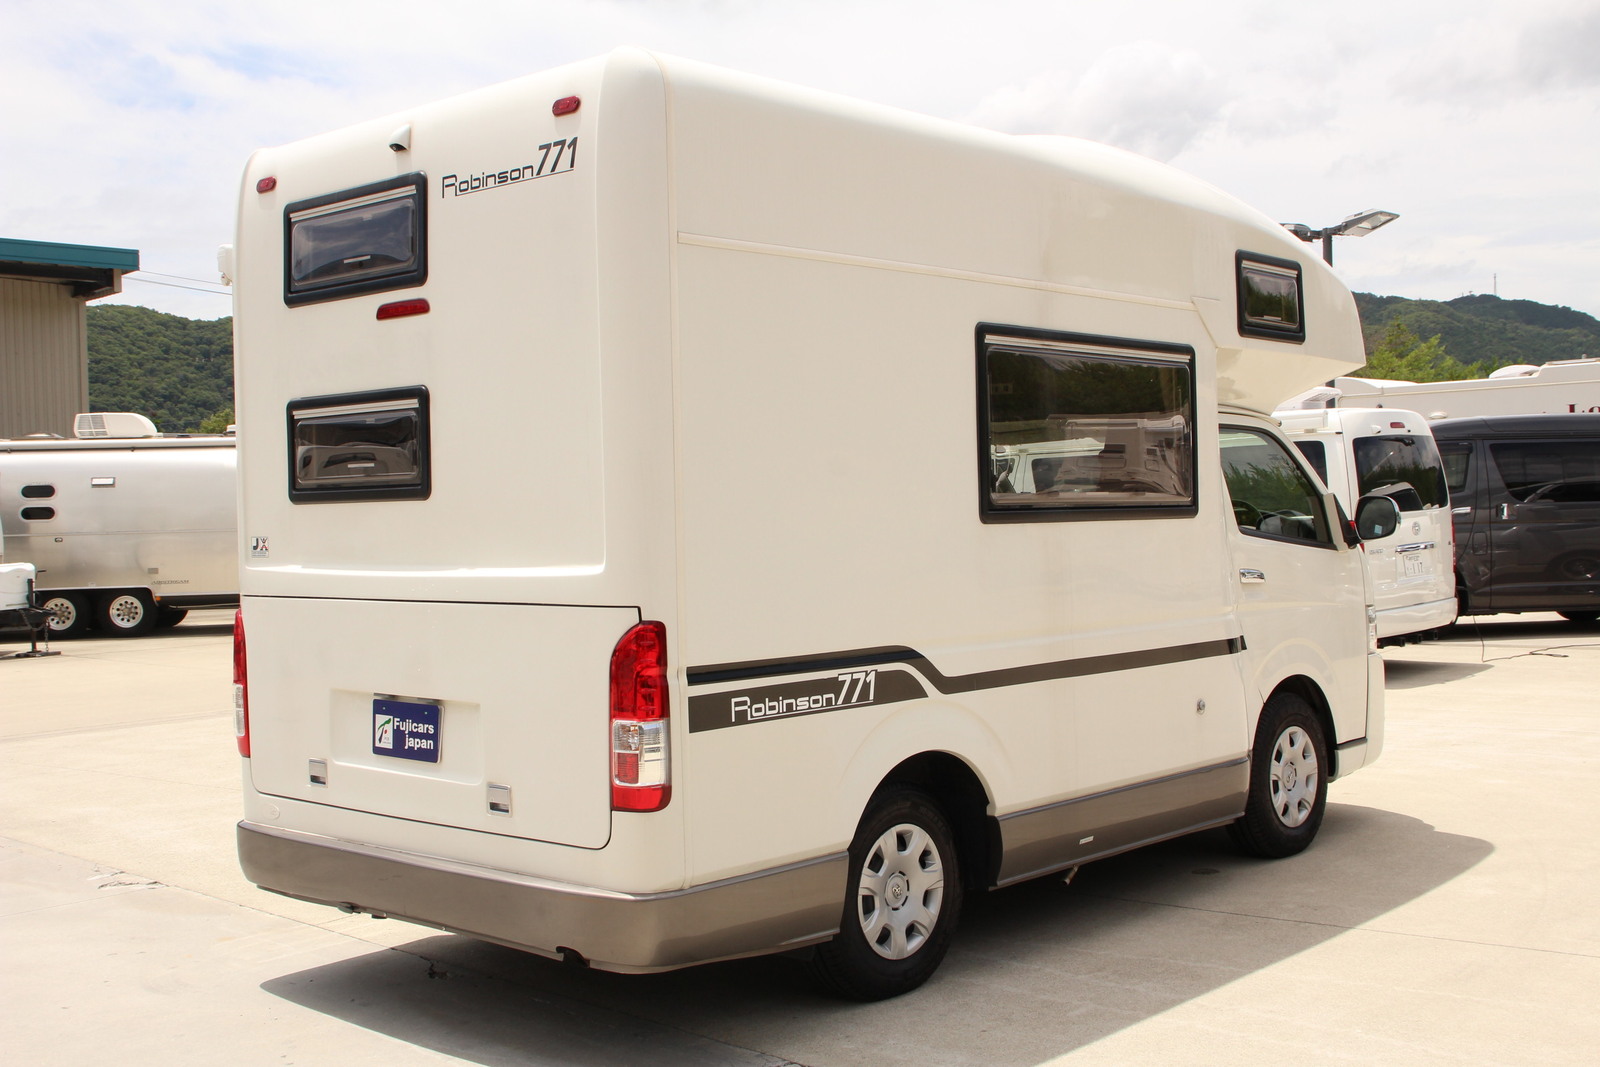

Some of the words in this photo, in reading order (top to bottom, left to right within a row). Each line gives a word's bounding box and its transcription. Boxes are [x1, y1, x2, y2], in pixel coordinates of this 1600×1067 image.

[441, 164, 534, 199] Robinson
[535, 136, 579, 176] 771
[731, 693, 835, 722] Robinson
[836, 670, 876, 705] 771
[393, 717, 435, 734] Fujicars
[404, 734, 434, 750] japan
